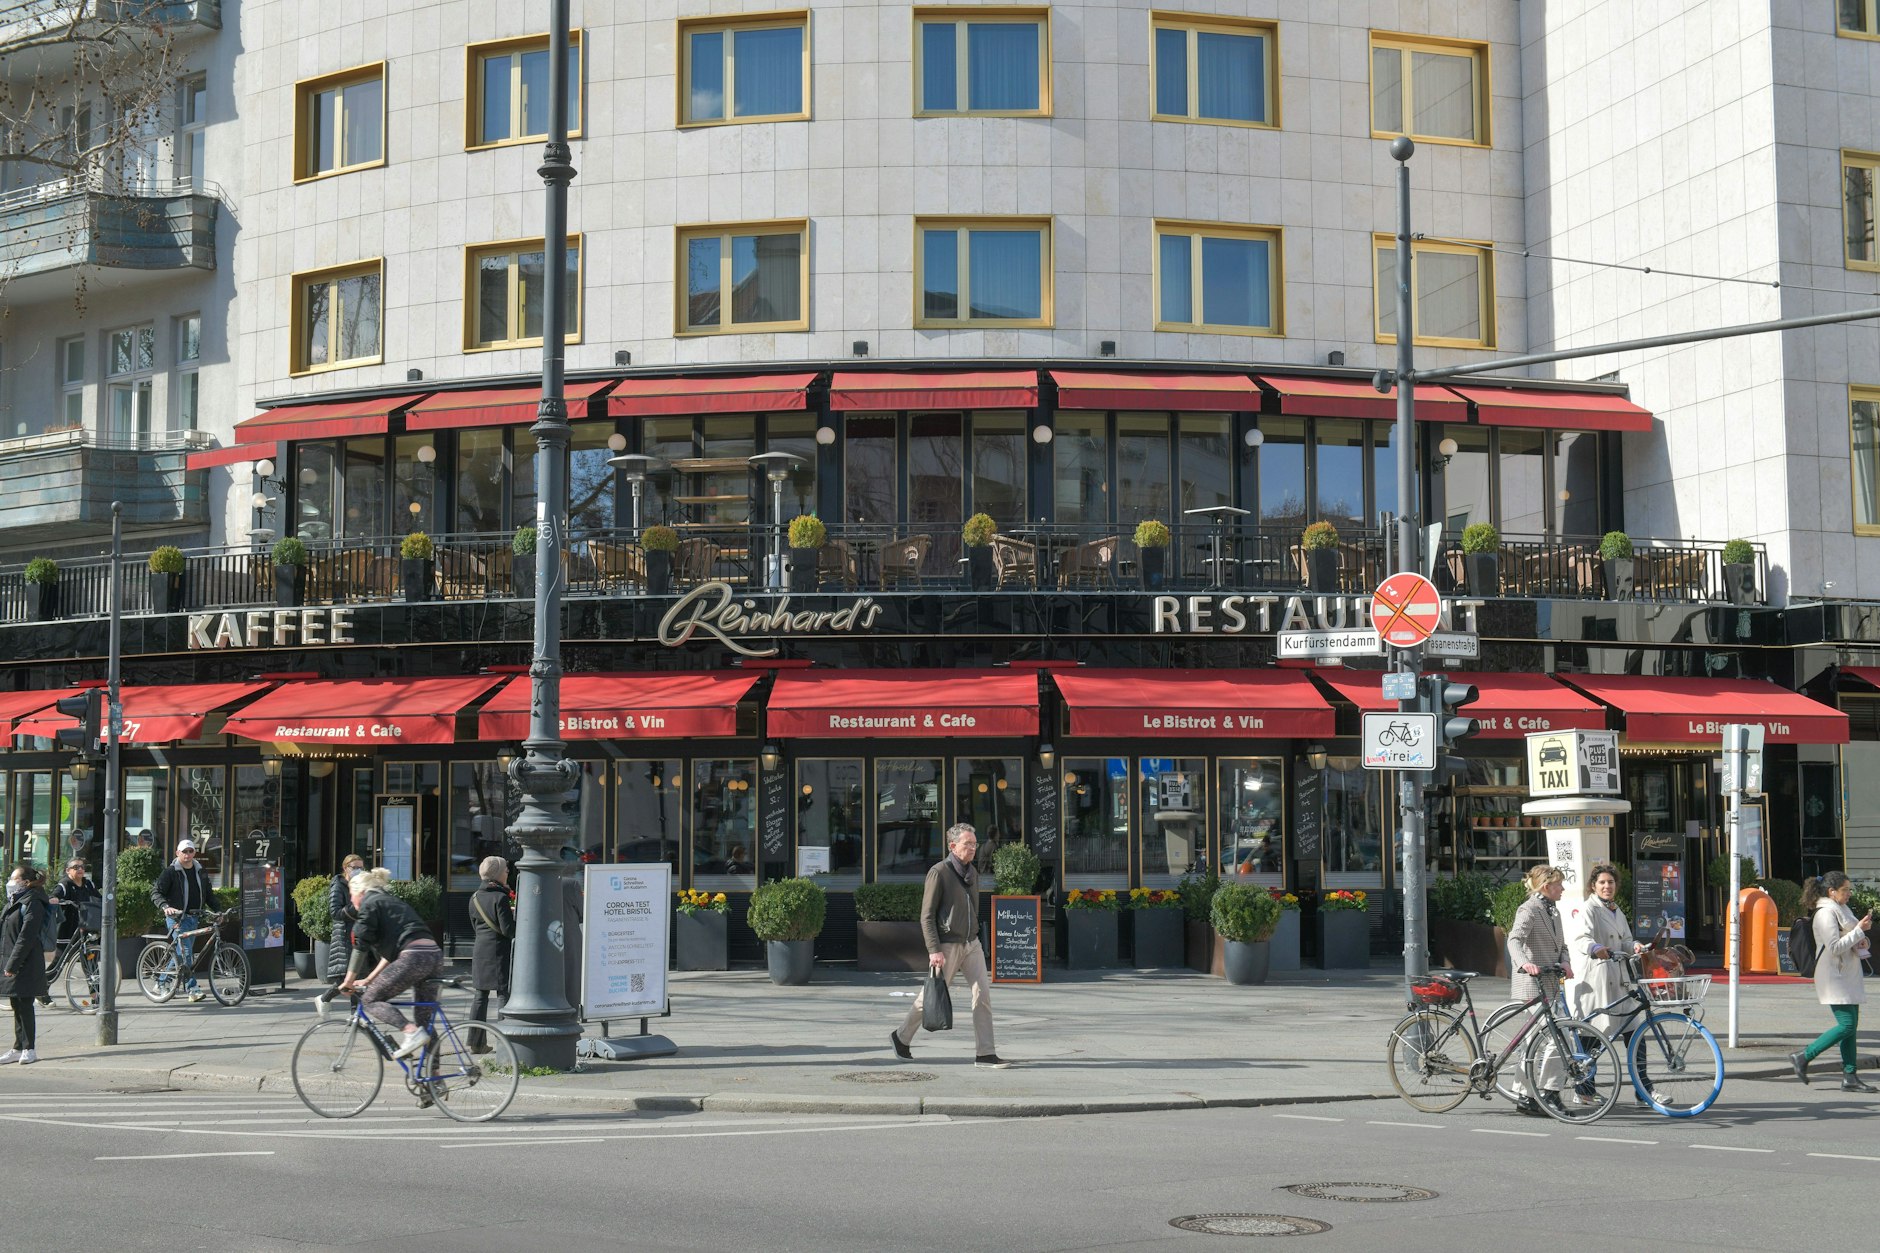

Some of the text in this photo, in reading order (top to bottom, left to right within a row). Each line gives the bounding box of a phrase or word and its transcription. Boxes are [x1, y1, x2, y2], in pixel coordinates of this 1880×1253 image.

[657, 581, 883, 657] Reinhard's
[187, 608, 355, 650] KAFFEE
[1284, 634, 1376, 650] Kurfürstendamm
[567, 717, 618, 730] Bistrot
[624, 716, 635, 729] &
[640, 715, 665, 729] Vin
[829, 713, 976, 728] Restaurant & Cafe
[1143, 715, 1264, 728] Le Bistrot & Vin
[1503, 716, 1513, 729] &
[1518, 716, 1550, 729] Cafe
[1688, 721, 1704, 733] Le
[122, 721, 140, 740] 27
[275, 724, 402, 737] Restaurant & Cafe
[1768, 722, 1790, 735] Vin
[1589, 746, 1605, 755] PLUS
[1590, 755, 1606, 764] SIZE
[1539, 769, 1569, 788] TAXI
[1542, 815, 1581, 827] TAXIRUF
[23, 830, 38, 853] 27
[255, 840, 270, 857] 27
[604, 908, 625, 916] HOTEL
